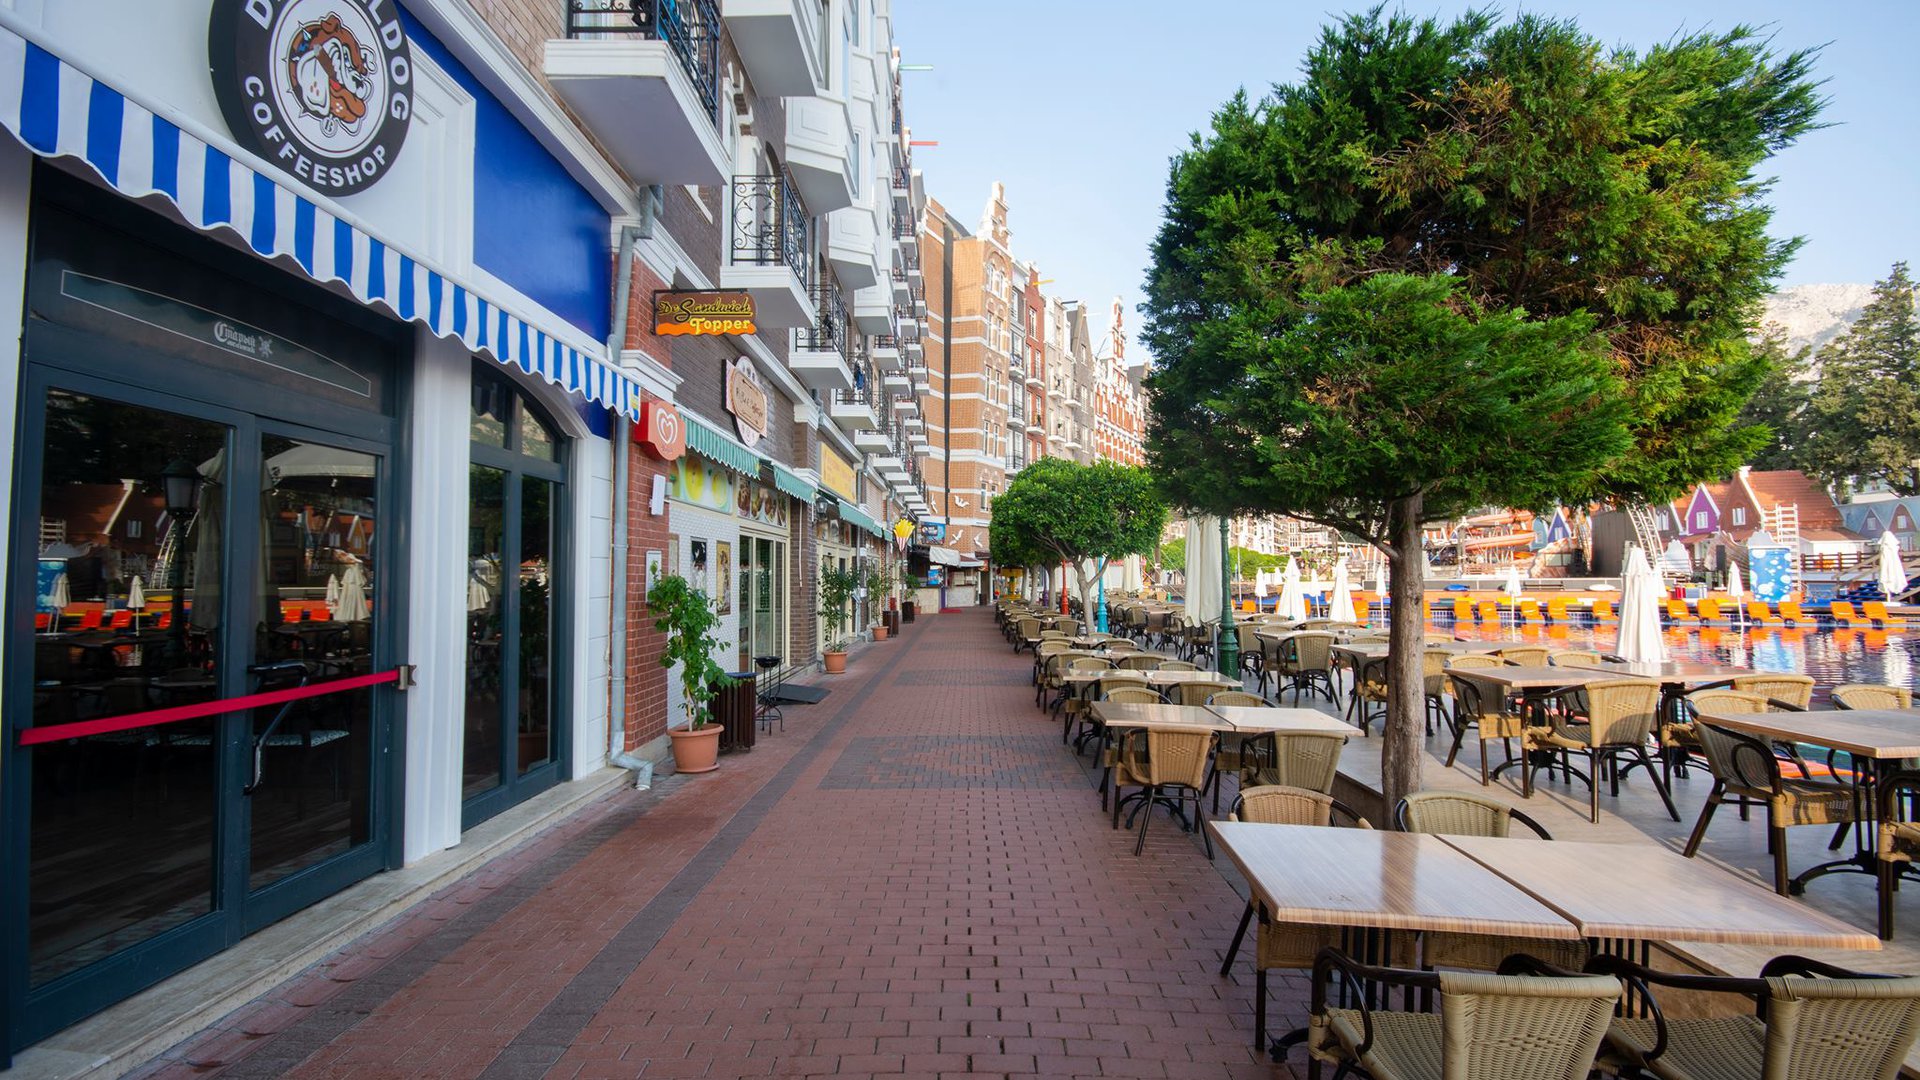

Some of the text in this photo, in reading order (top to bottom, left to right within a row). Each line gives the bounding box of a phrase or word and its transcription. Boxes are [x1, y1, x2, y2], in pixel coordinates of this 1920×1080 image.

[361, 0, 409, 121] LDOG
[245, 76, 386, 188] COFFEESHOP
[674, 297, 753, 323] Sandwich
[690, 317, 750, 335] Topper
